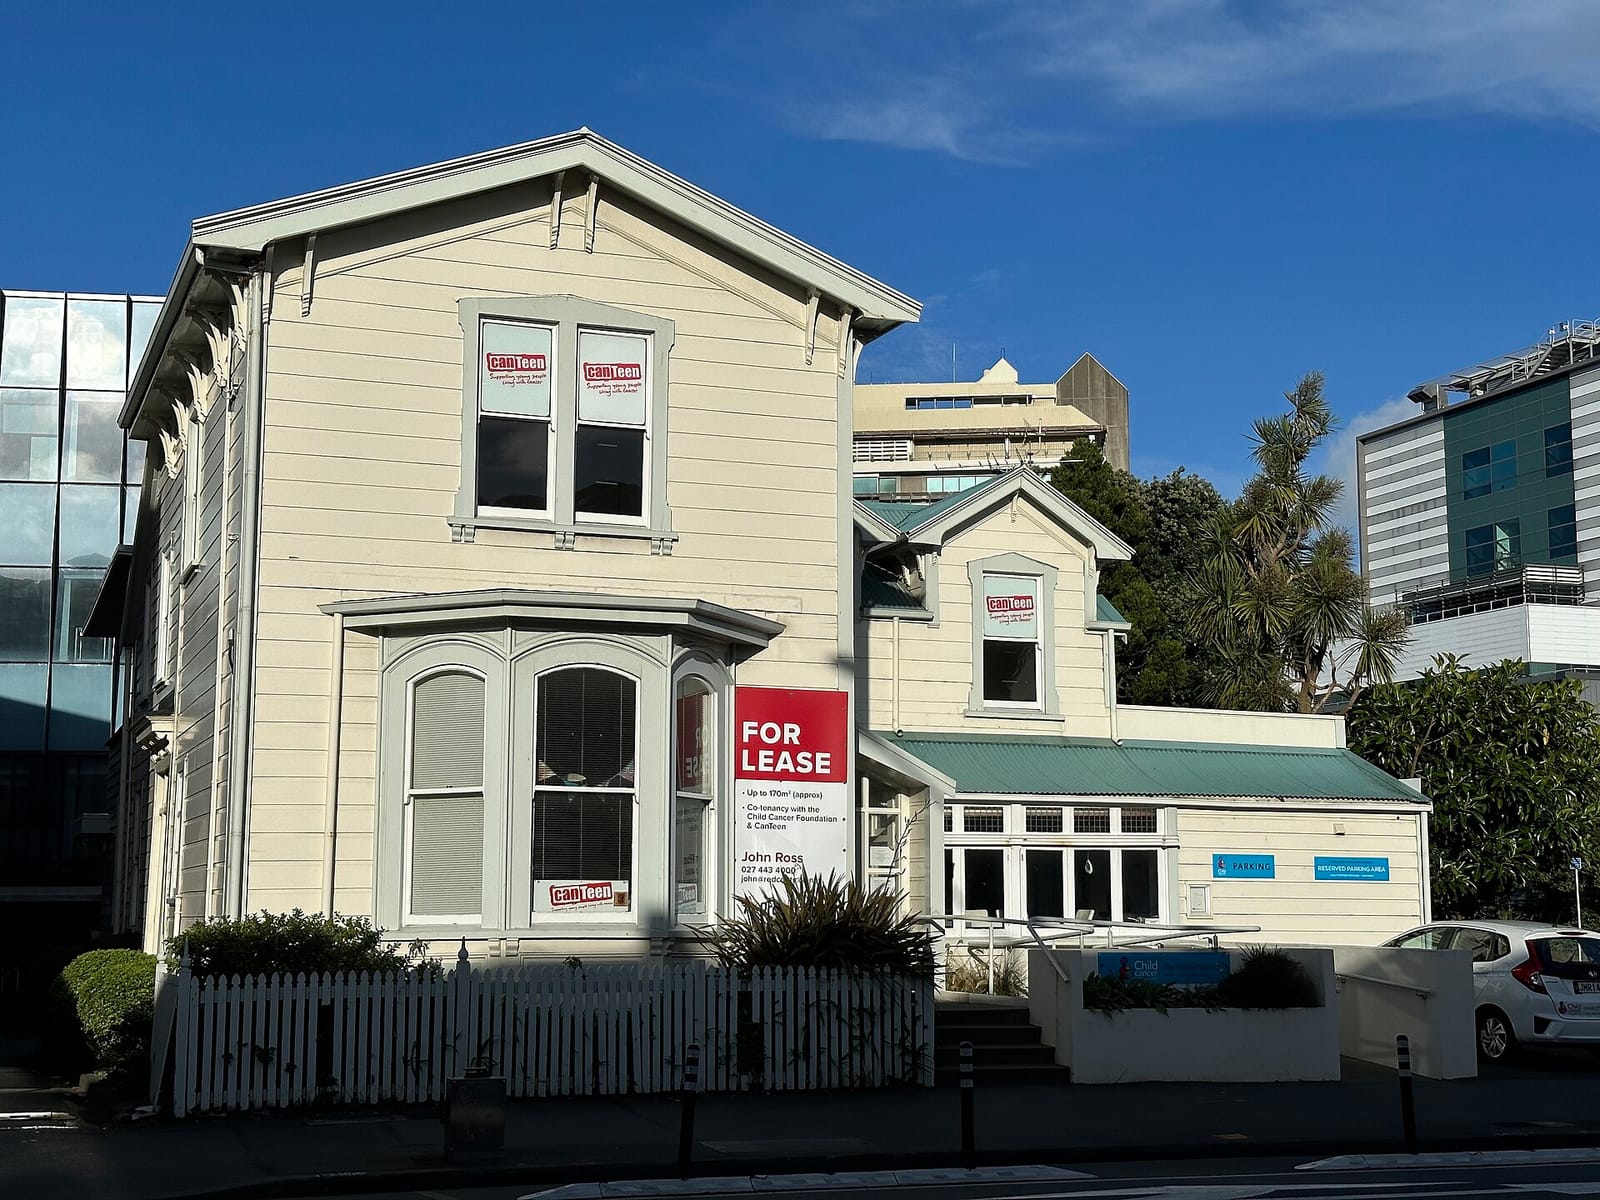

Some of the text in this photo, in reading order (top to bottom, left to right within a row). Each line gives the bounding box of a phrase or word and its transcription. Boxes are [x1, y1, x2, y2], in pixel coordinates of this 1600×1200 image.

[490, 356, 545, 370] canTeen
[586, 366, 640, 379] canTeen
[990, 598, 1033, 609] canTeen
[742, 722, 800, 744] FOR
[742, 750, 831, 774] LEASE
[746, 789, 758, 797] Up
[792, 791, 822, 800] (approx)
[747, 804, 789, 813] Co-tenancy
[742, 852, 803, 863] John Ross
[1233, 862, 1271, 870] PARKING
[554, 886, 612, 902] canTeen
[1134, 960, 1158, 970] Child
